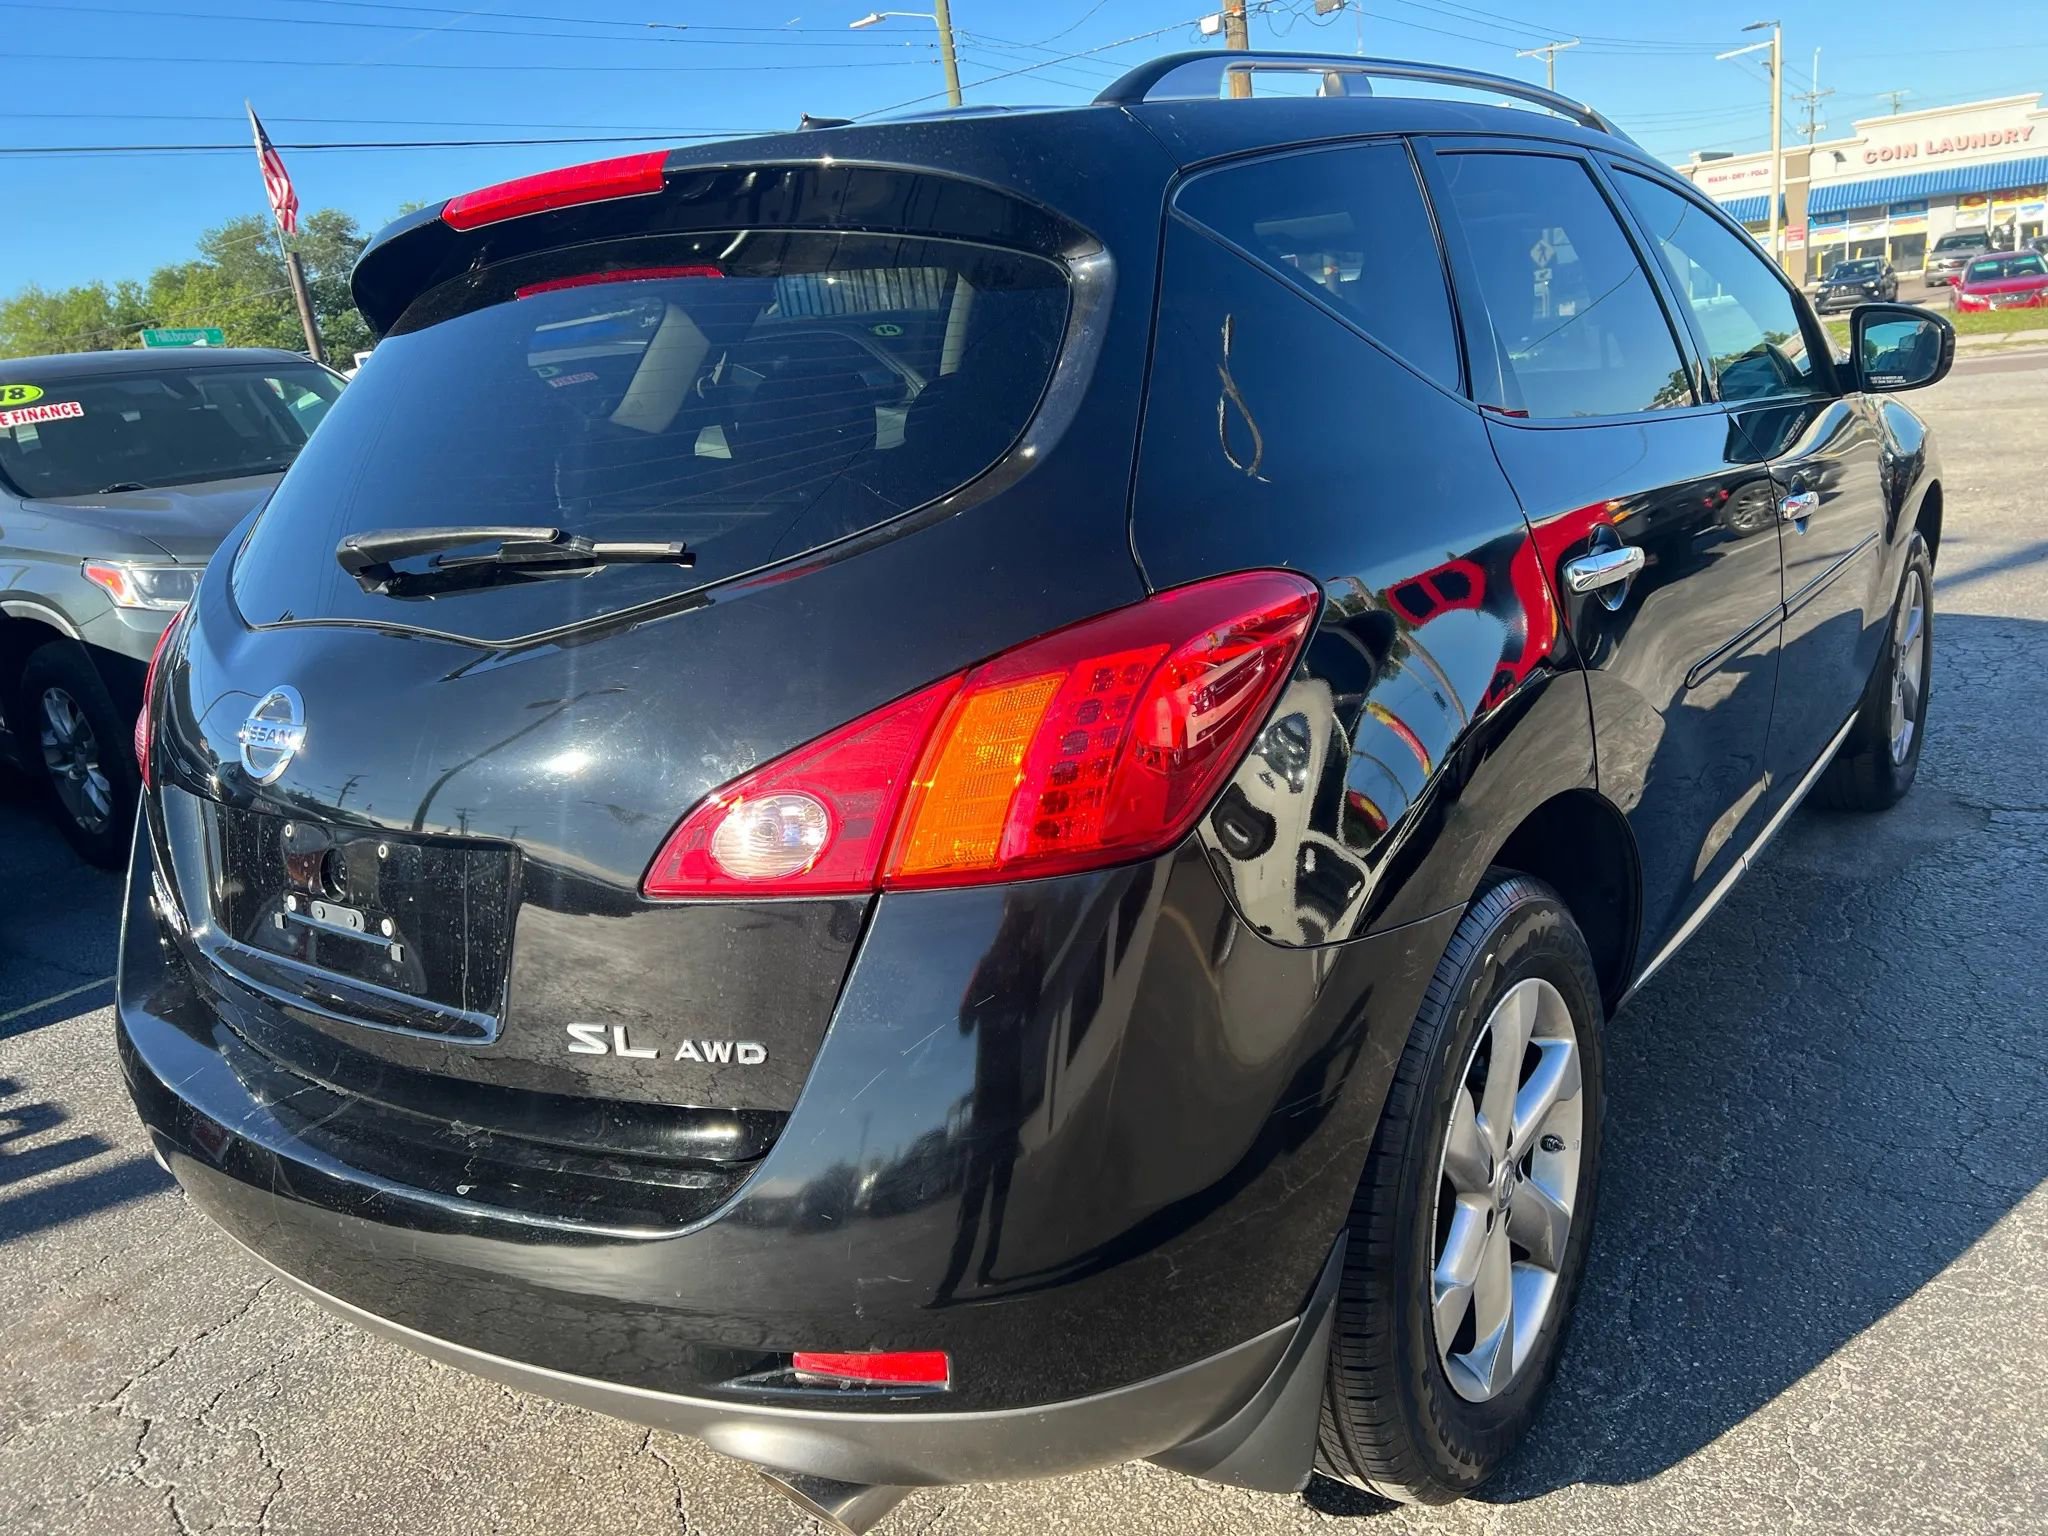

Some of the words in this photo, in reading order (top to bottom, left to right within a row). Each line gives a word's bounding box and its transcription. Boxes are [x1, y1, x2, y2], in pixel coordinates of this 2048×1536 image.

[1863, 142, 1918, 164] COIN
[1925, 125, 2035, 155] LAUNDRY
[1732, 172, 1745, 180] DRY
[11, 403, 81, 424] FINANCE
[566, 1022, 660, 1059] SL
[674, 1039, 769, 1065] AWD
